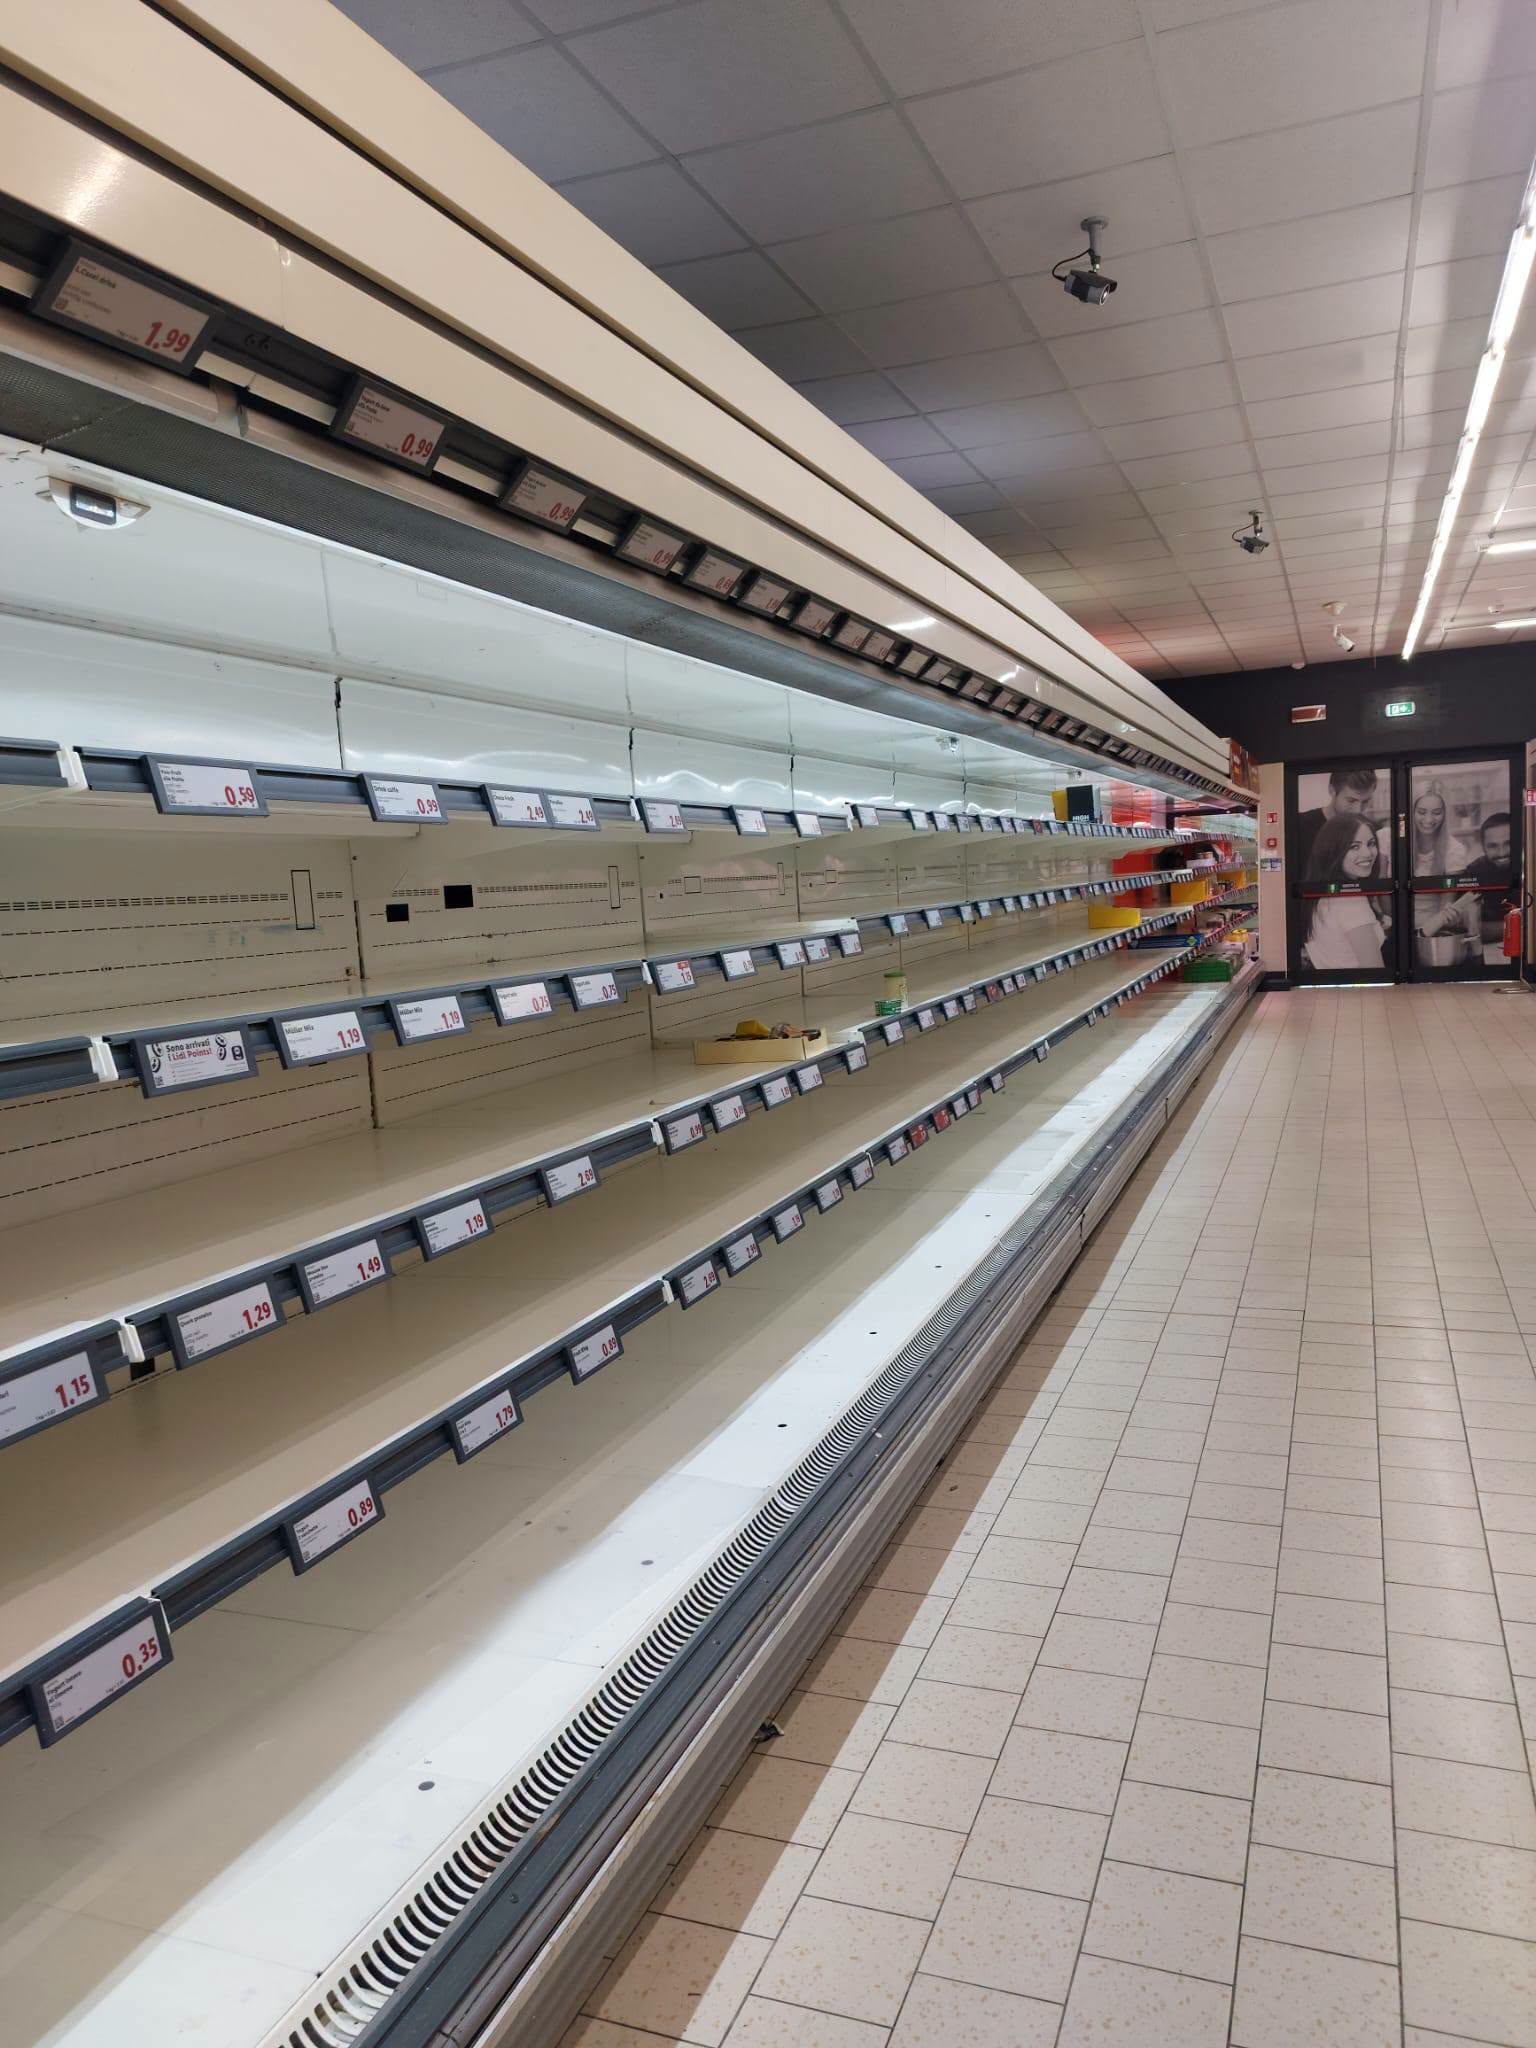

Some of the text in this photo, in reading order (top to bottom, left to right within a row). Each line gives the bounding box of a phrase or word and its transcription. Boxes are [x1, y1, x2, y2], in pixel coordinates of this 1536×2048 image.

[144, 321, 192, 353] 1.99
[401, 433, 433, 458] 0.99
[549, 502, 575, 521] 0.99
[224, 786, 255, 806] 0.59
[416, 798, 438, 815] 0.99
[526, 805, 544, 821] 2.49
[578, 809, 594, 824] 2.49
[1072, 814, 1090, 822] HIGH
[602, 984, 617, 1000] 0.75
[532, 995, 549, 1012] 0.75
[441, 1010, 460, 1030] 1.19
[166, 1038, 210, 1053] Sono arrivati
[337, 1028, 360, 1049] 1.19
[172, 1050, 186, 1062] Lidl
[188, 1047, 213, 1059] Points!
[465, 1214, 484, 1235] 1.19
[357, 1256, 381, 1281] 1.49
[242, 1301, 272, 1331] 1.29
[601, 1337, 617, 1358] 0.89
[55, 1373, 91, 1409] 1.15
[495, 1404, 514, 1429] 1.79
[347, 1496, 374, 1528] 0.89
[121, 1637, 159, 1679] 0.35
[47, 1681, 66, 1697] Yogurt
